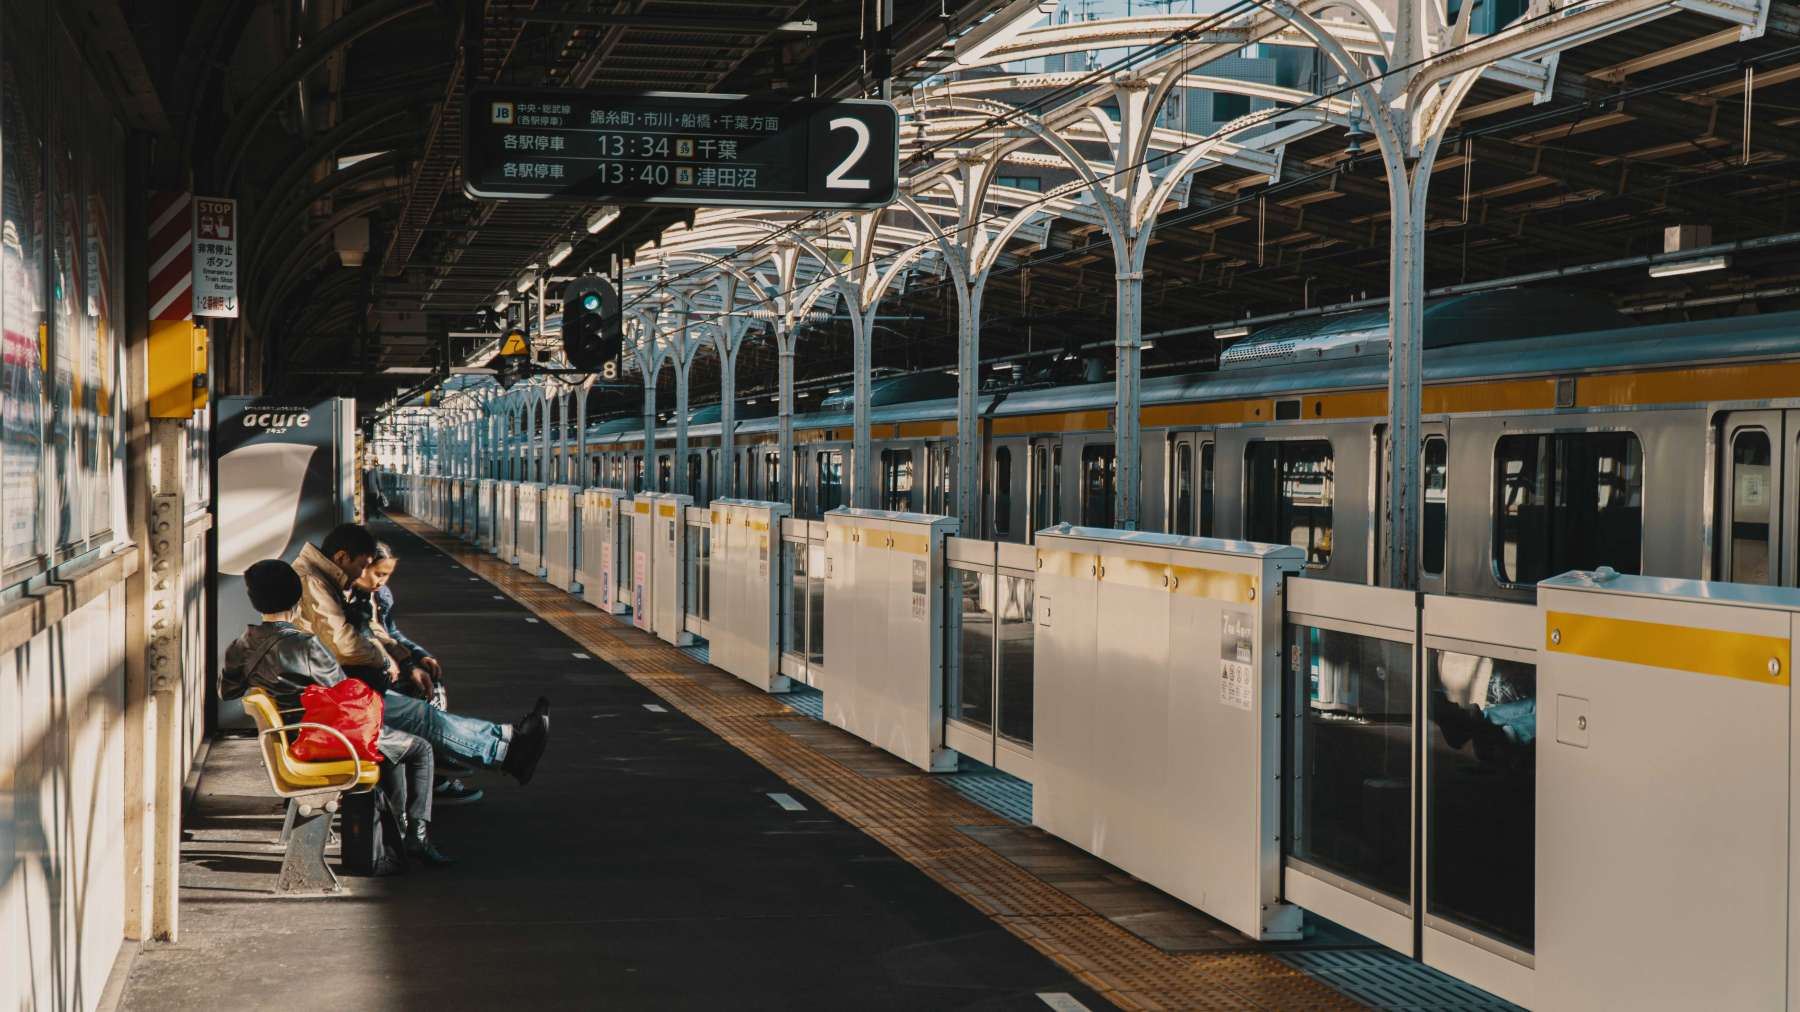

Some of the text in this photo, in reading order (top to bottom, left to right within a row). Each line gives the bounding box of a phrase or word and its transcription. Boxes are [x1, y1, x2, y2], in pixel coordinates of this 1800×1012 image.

[495, 107, 509, 119] JB
[503, 134, 670, 157] 各駅停車 13:34
[697, 139, 737, 160] 千葉
[825, 117, 871, 189] 2
[503, 162, 669, 185] 各駅停車 13:40
[697, 167, 757, 188] 津田沼
[200, 202, 231, 214] STOP
[198, 243, 233, 256] 非常停止
[206, 257, 233, 268] ボタン
[603, 361, 616, 379] 8
[242, 413, 311, 428] acure
